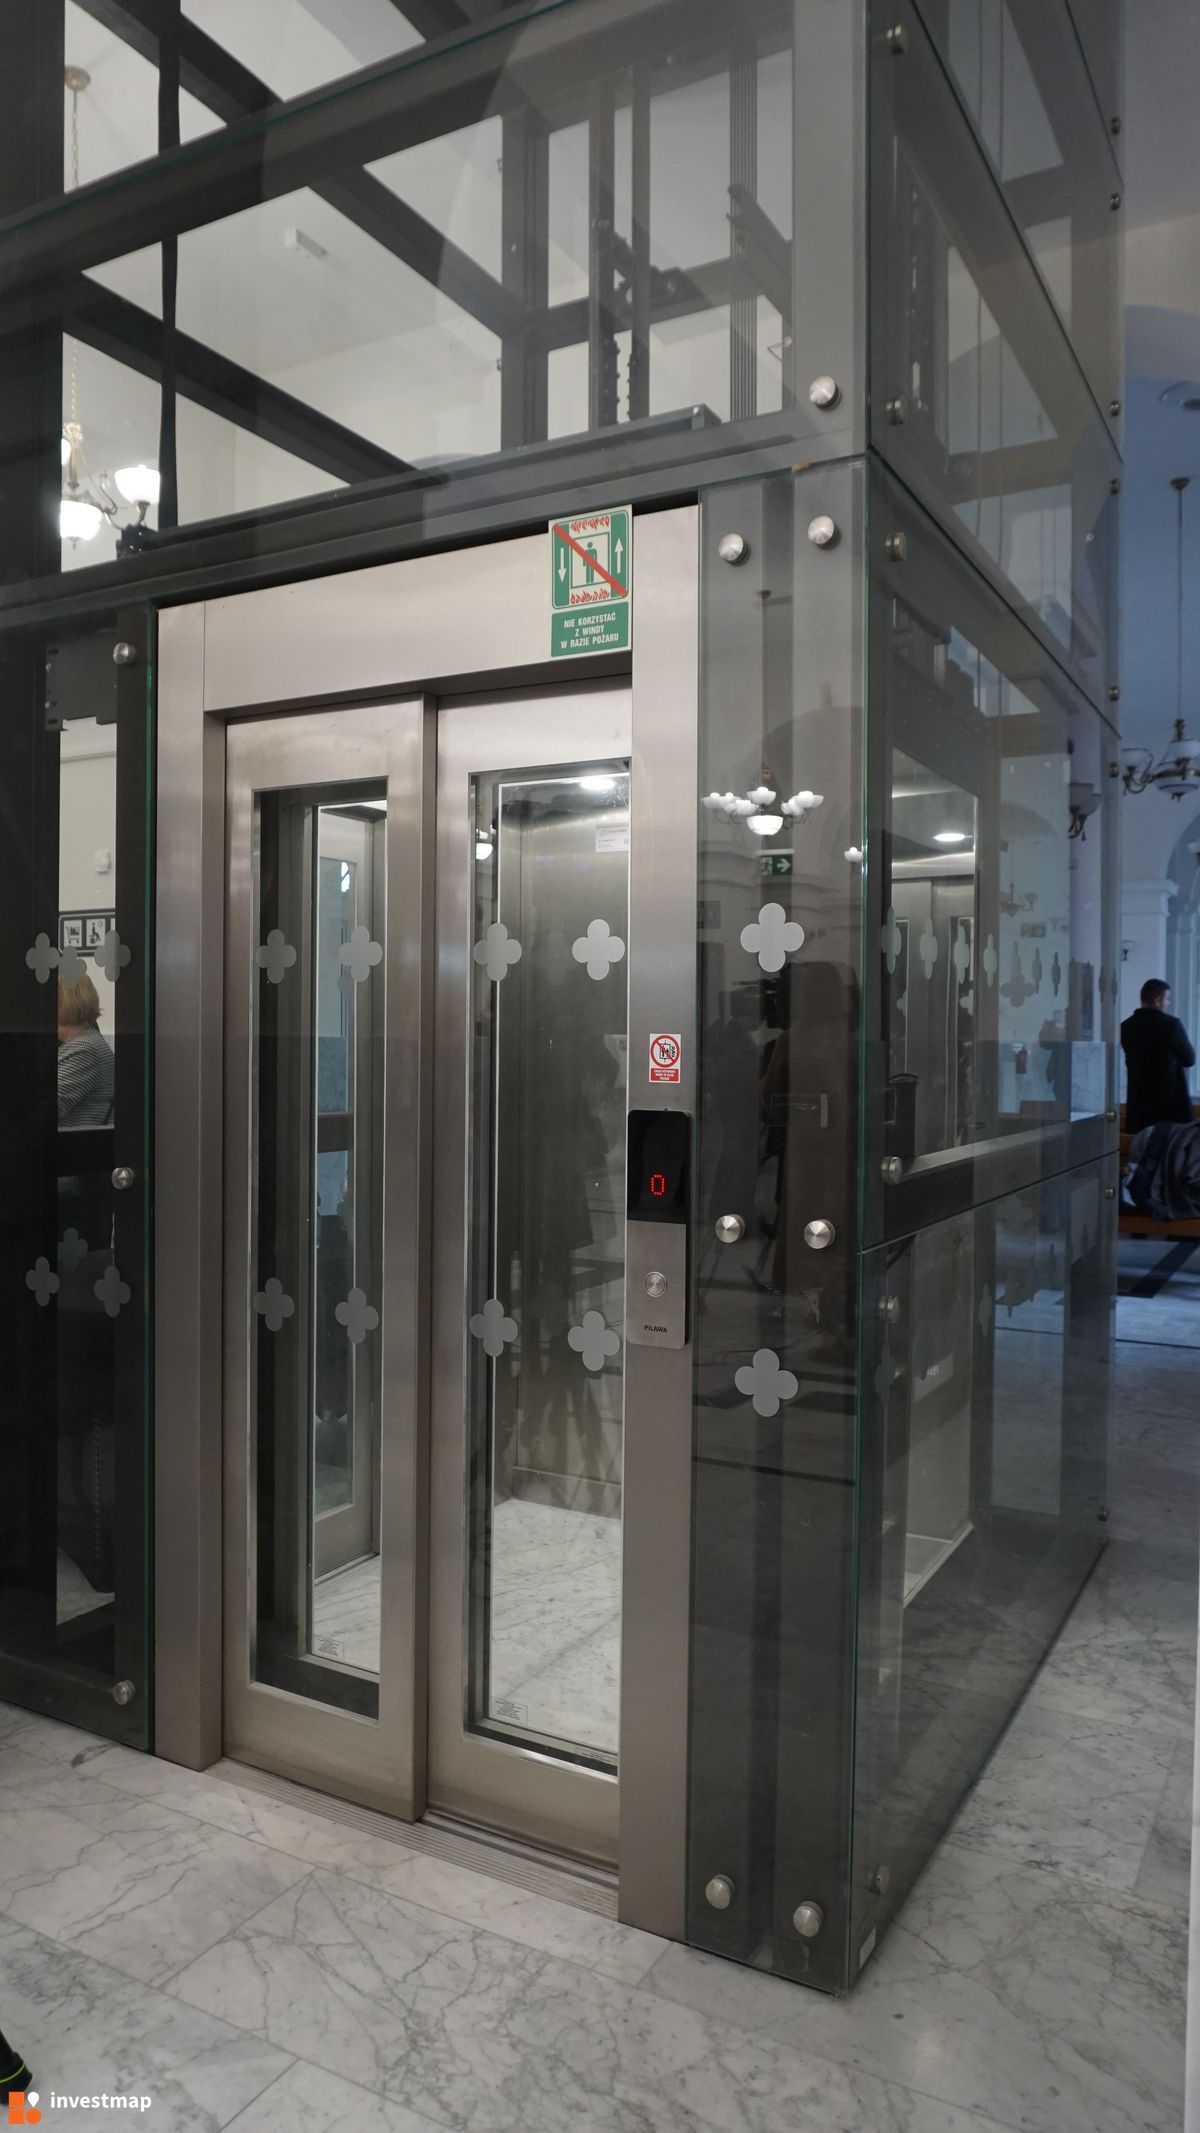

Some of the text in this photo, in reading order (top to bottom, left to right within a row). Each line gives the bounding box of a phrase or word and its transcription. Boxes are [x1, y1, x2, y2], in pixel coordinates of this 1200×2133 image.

[564, 611, 616, 628] NIE KORZYSTAĆ
[575, 625, 605, 637] Z WINDY
[561, 633, 619, 649] W RAZIE POŻARU
[650, 1174, 665, 1196] 0
